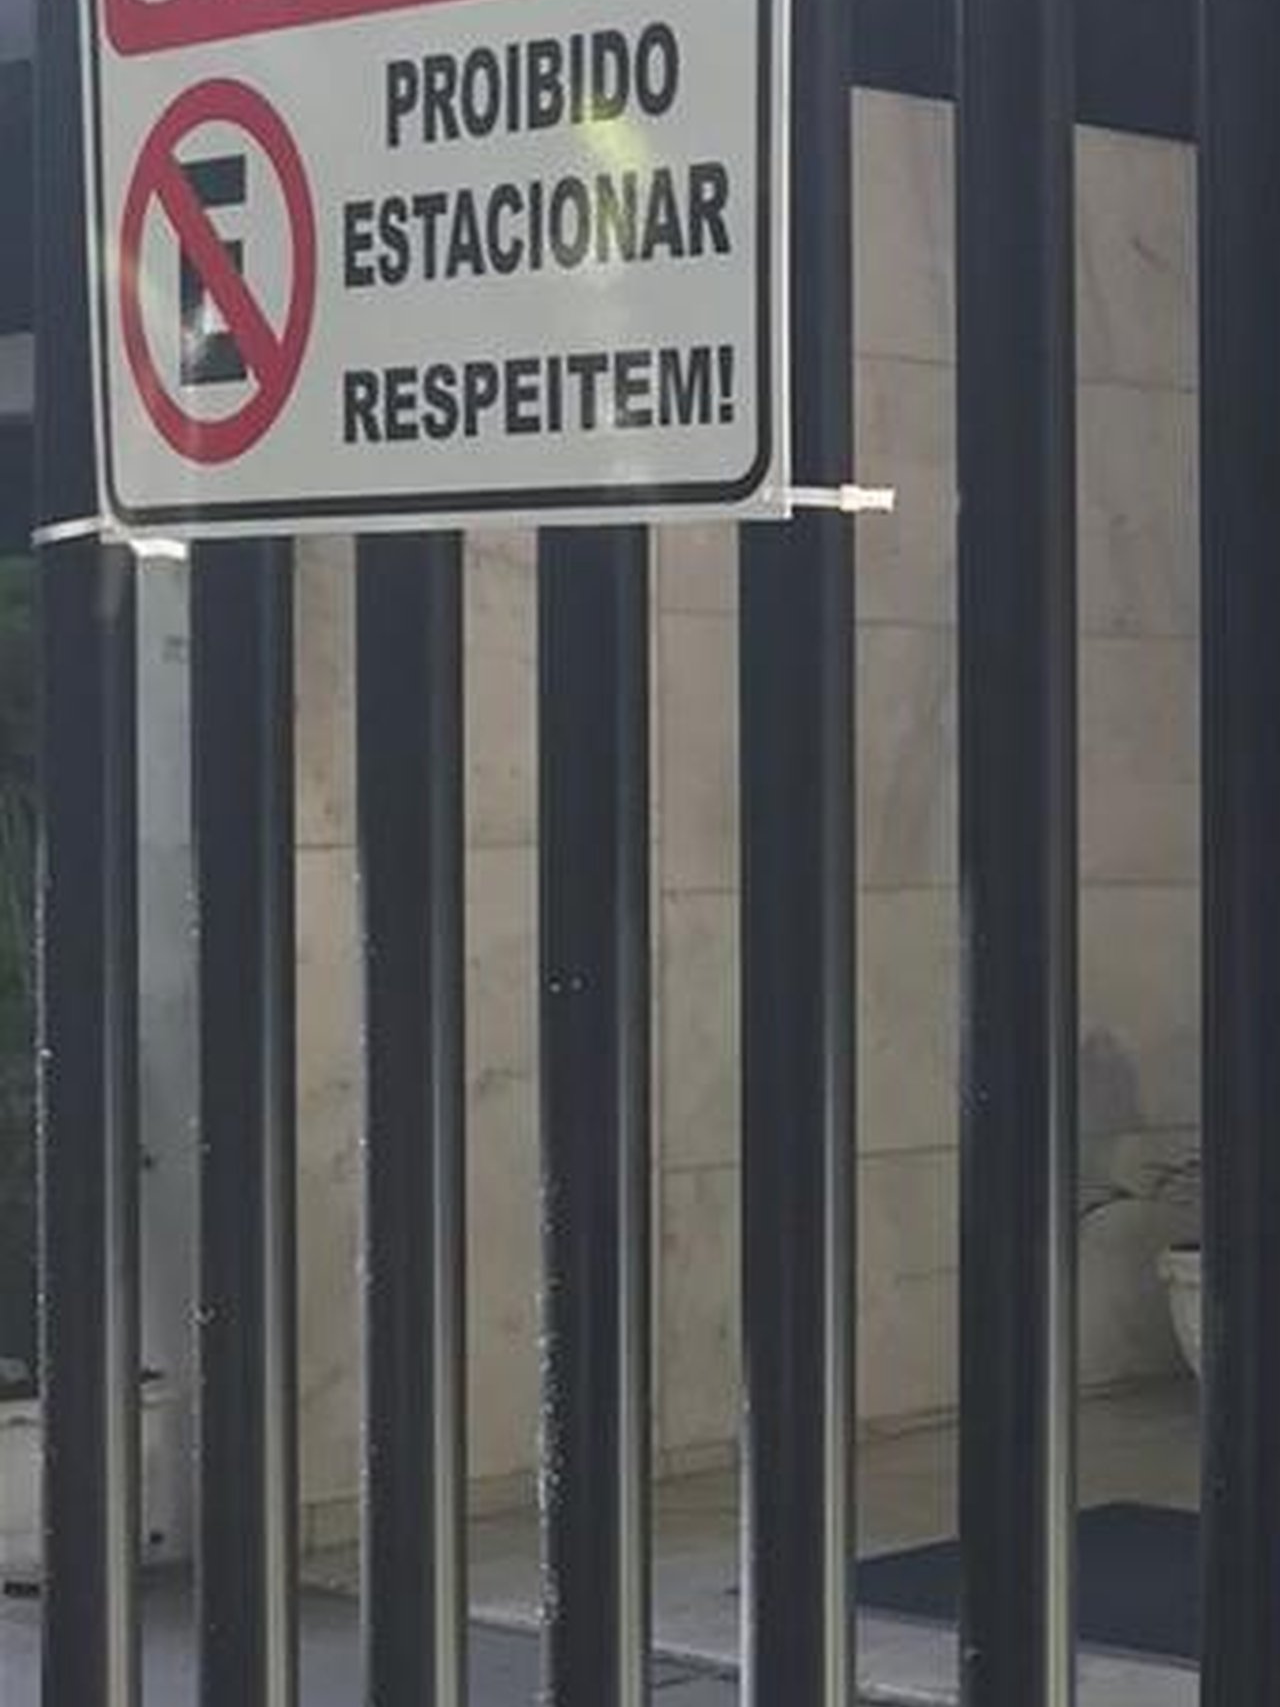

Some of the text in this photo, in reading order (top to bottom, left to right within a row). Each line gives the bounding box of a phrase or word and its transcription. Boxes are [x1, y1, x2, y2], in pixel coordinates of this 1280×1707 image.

[387, 22, 679, 147] PROIBIDO
[344, 162, 731, 288] ESTACIONAR
[344, 344, 736, 443] RESPEITEM!
